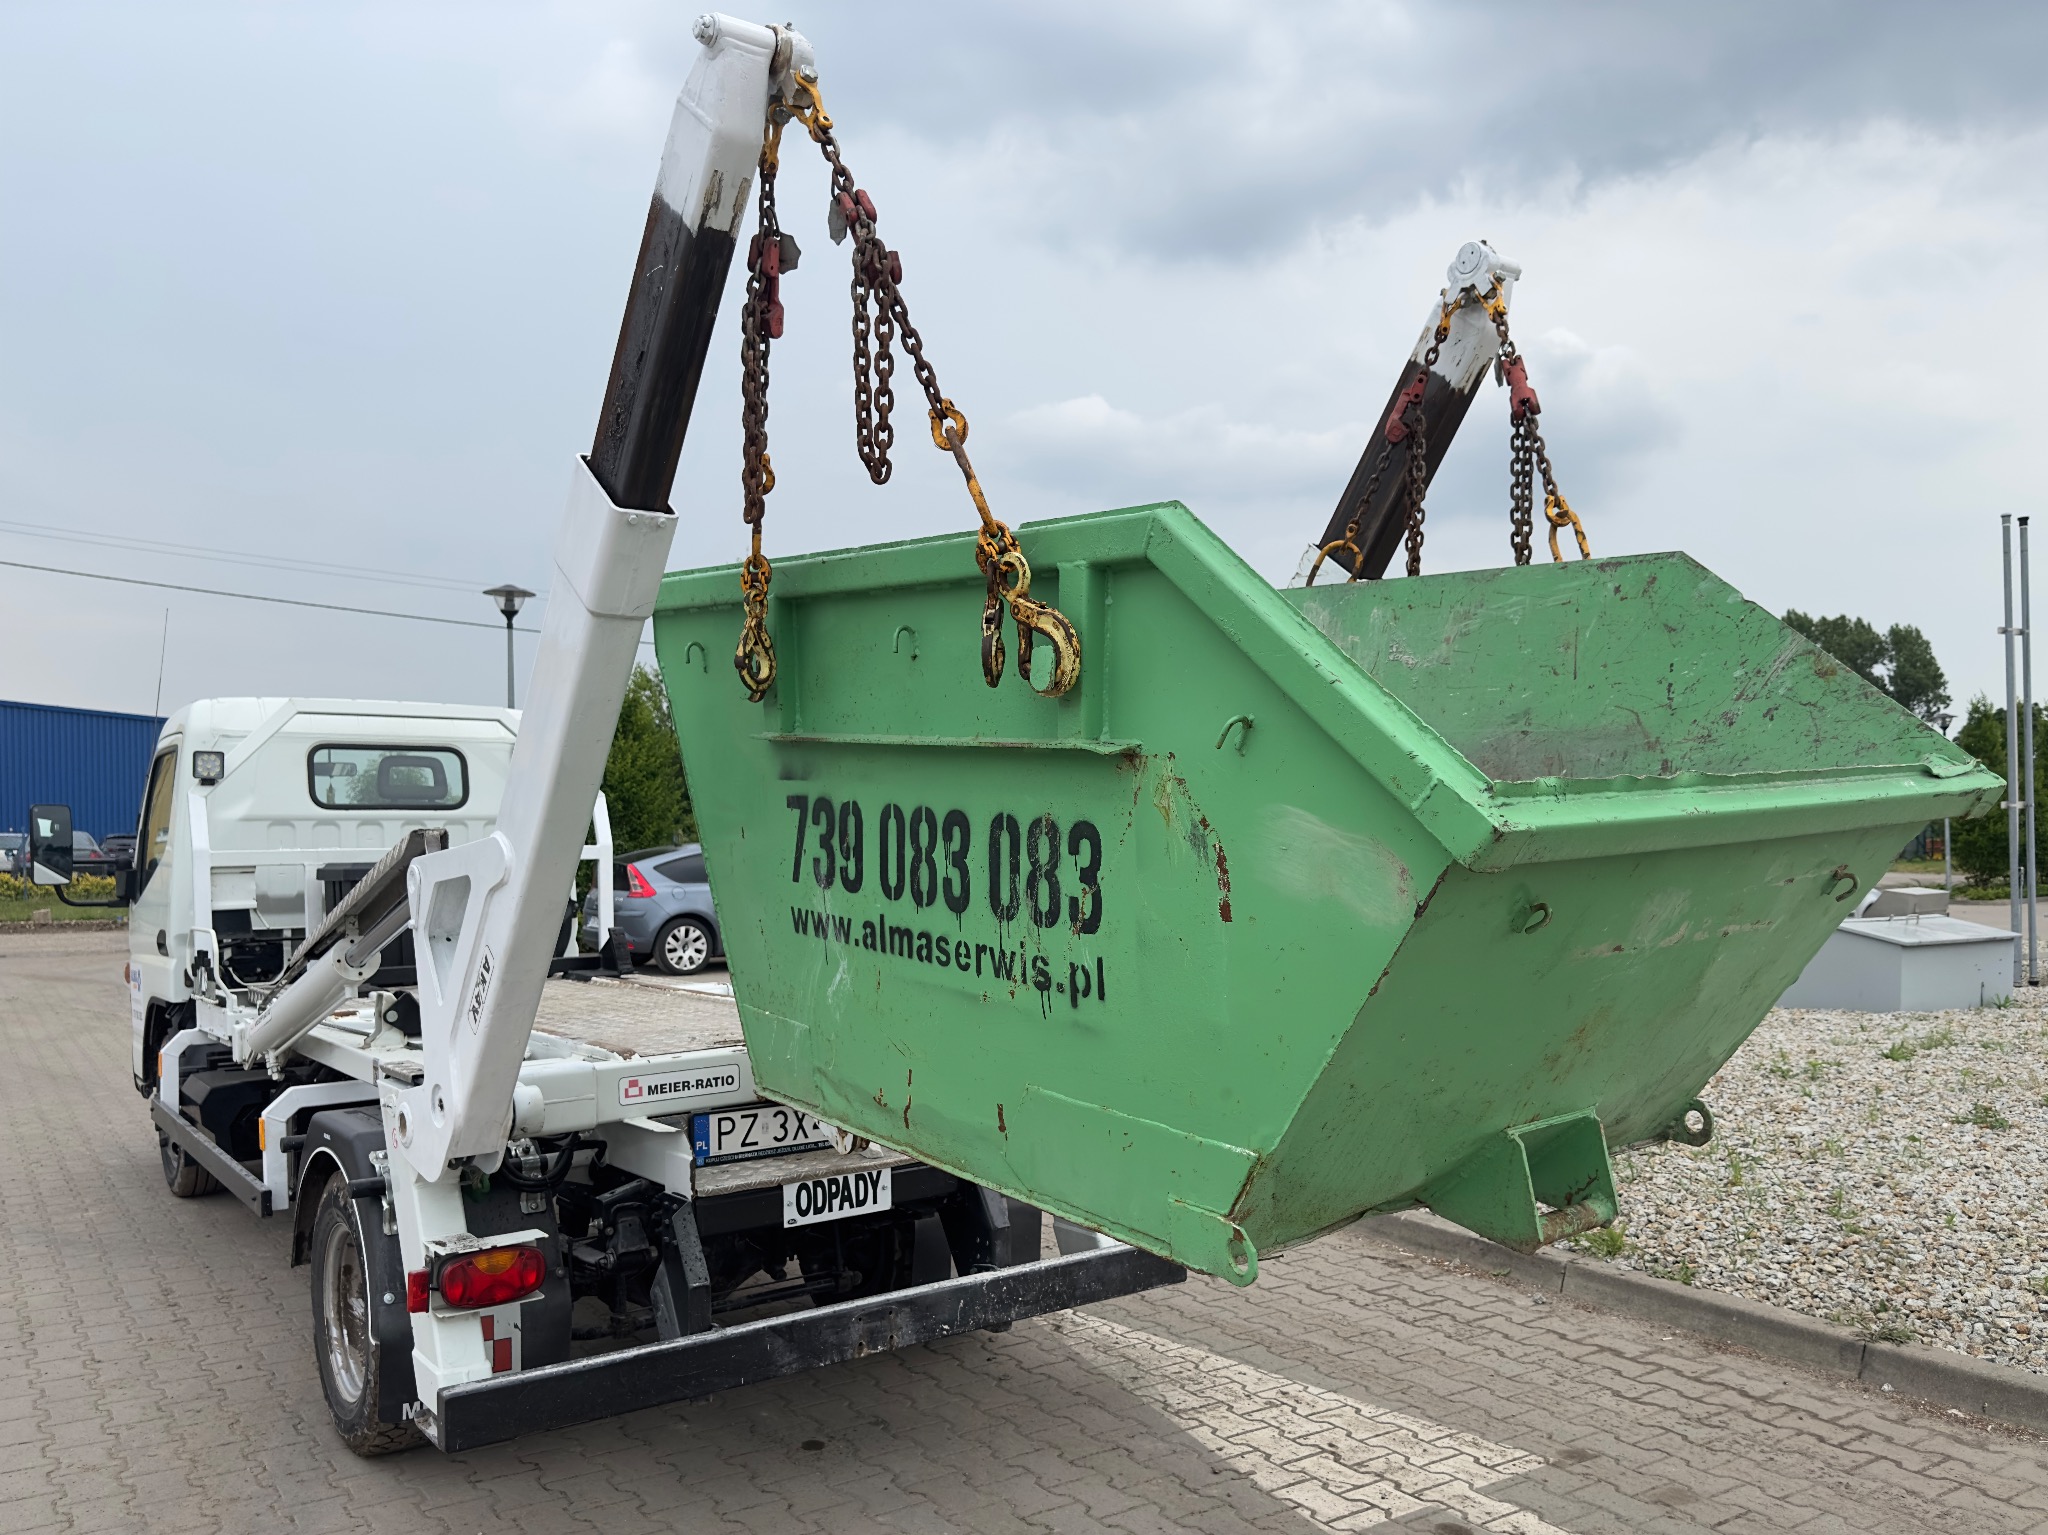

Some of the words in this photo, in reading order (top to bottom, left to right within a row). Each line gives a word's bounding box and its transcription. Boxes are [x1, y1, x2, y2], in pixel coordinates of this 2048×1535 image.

[786, 794, 864, 894] 739
[879, 803, 971, 914] 083
[988, 812, 1103, 935] 083
[790, 906, 1106, 1009] www.almaserwis.pl
[647, 1074, 735, 1096] MEIER-RATIO
[696, 1141, 708, 1150] PL
[717, 1113, 759, 1151] PZ
[772, 1109, 820, 1143] 3X
[795, 1169, 882, 1218] ODPADY
